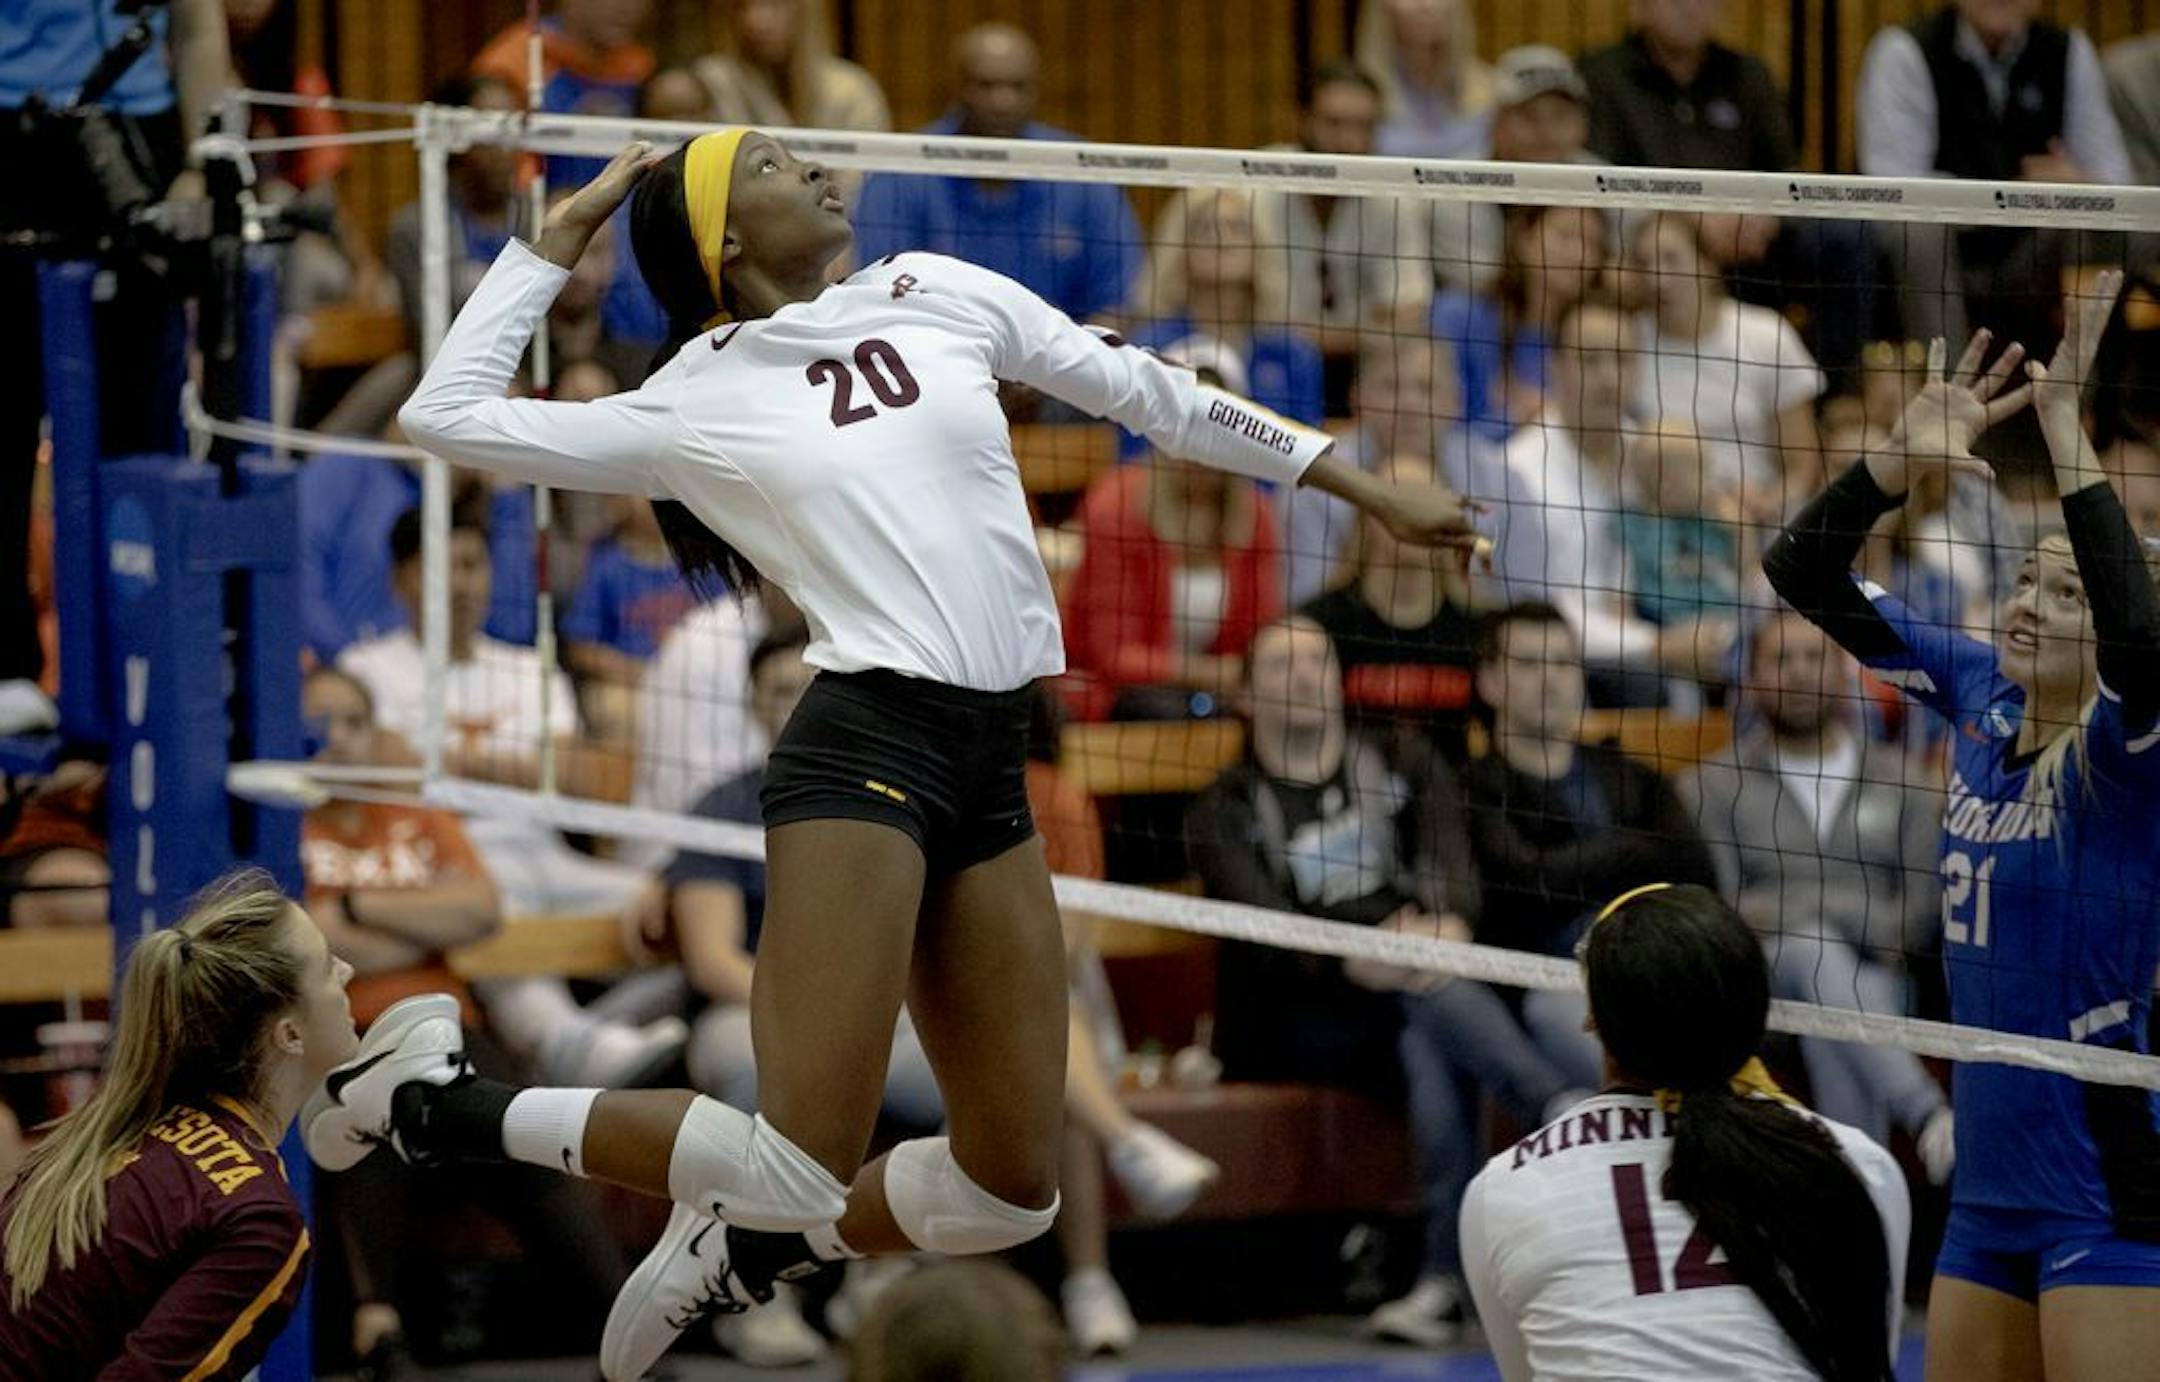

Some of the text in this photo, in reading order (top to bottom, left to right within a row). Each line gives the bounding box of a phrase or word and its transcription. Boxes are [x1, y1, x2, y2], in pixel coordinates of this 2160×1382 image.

[806, 338, 920, 428] 20
[1208, 399, 1297, 455] GOPHERS
[1940, 851, 1996, 948] 21
